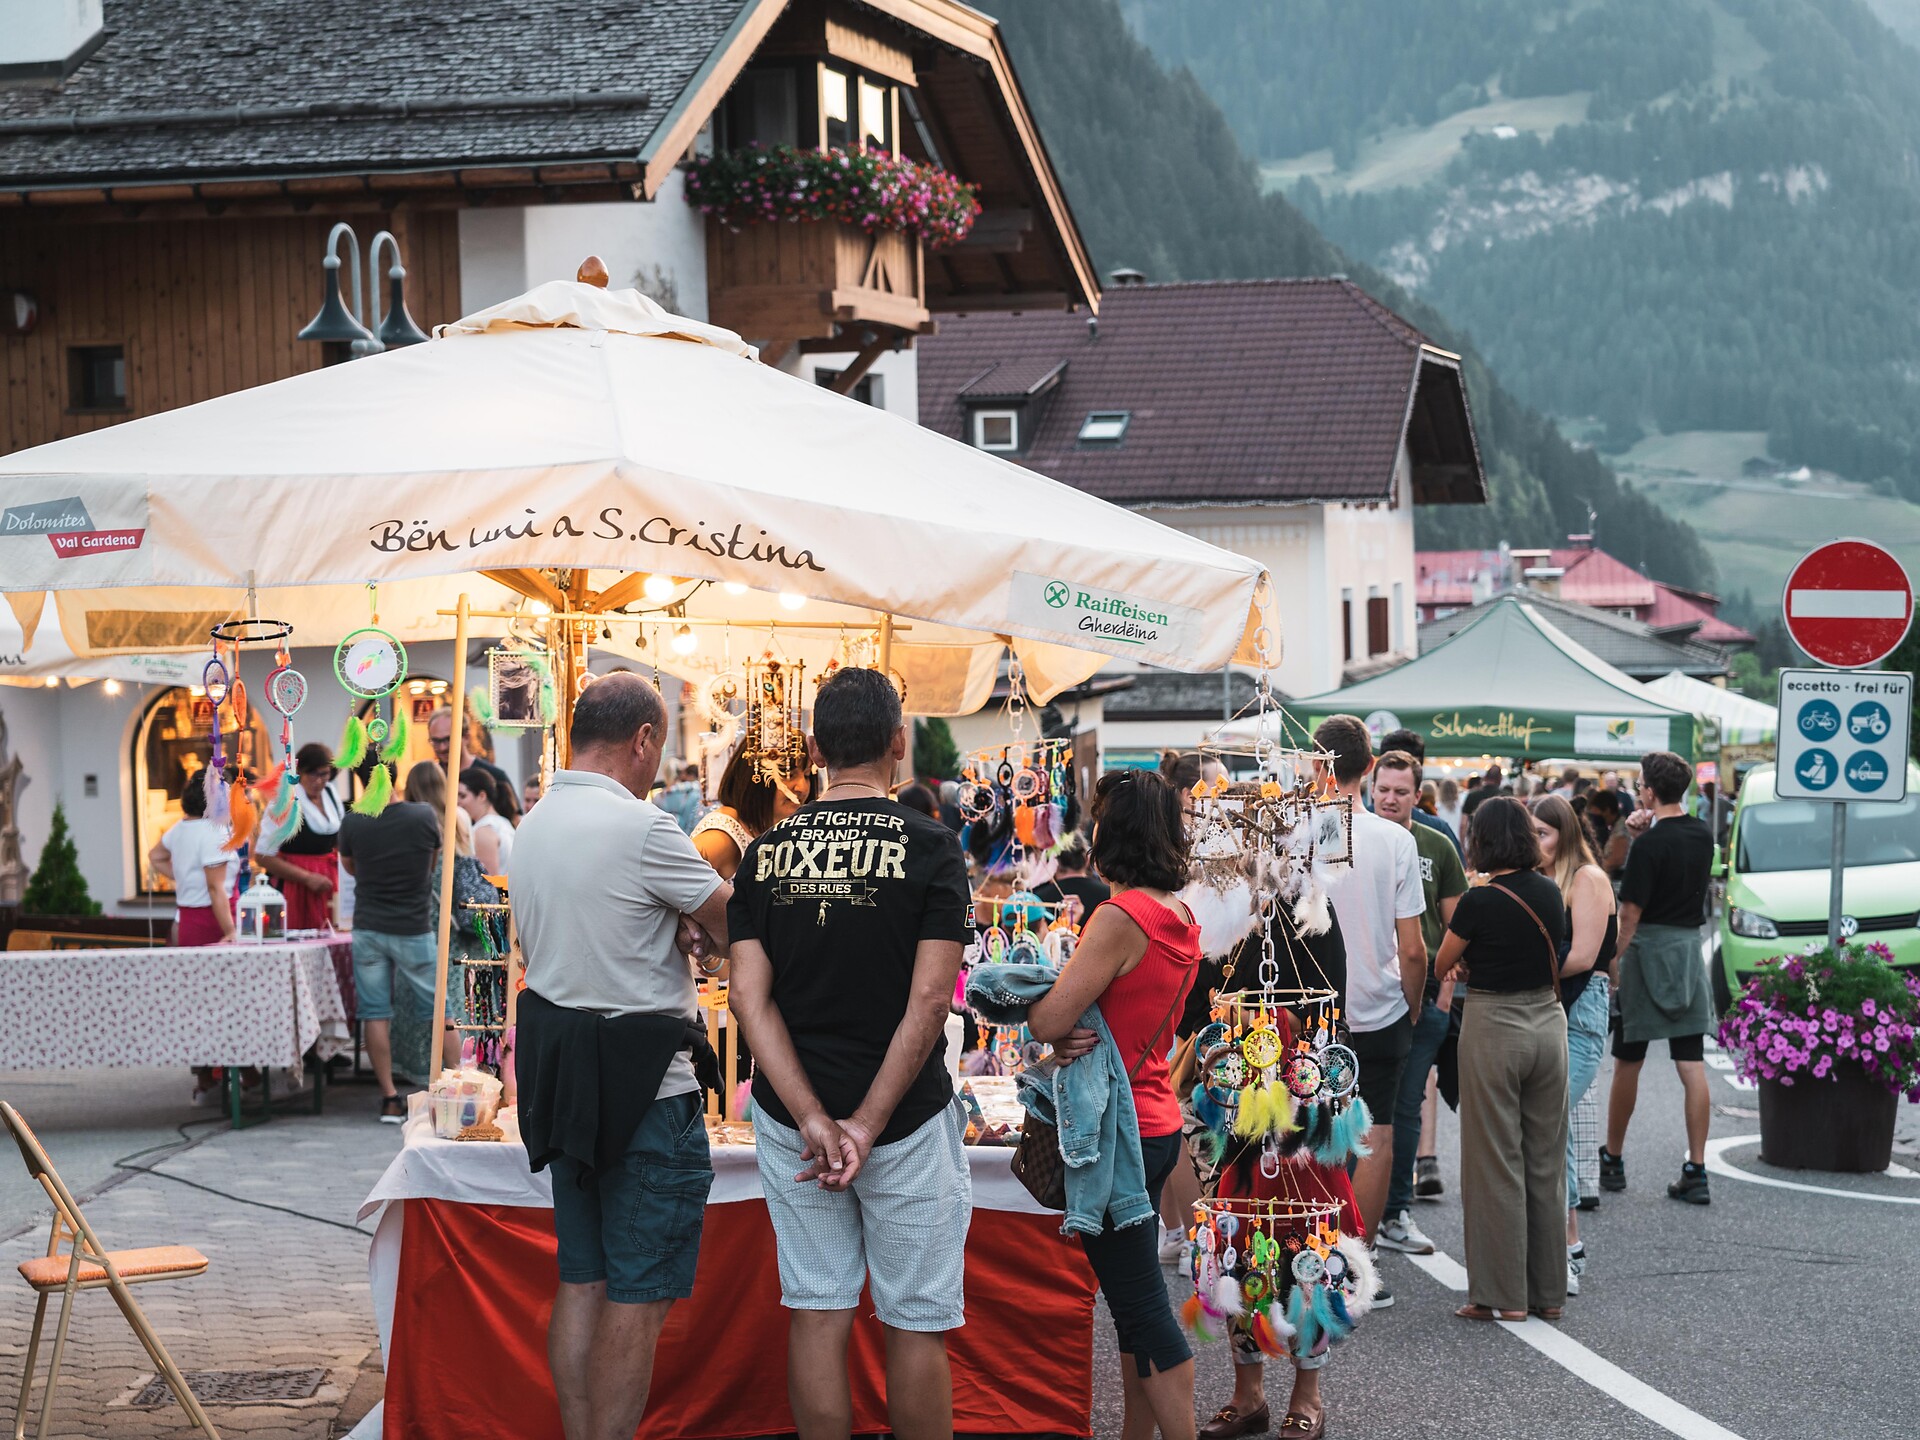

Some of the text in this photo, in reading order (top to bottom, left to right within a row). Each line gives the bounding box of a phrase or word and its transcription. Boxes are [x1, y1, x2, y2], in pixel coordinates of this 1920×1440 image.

[6, 512, 87, 531] Dolomites
[56, 534, 136, 549] Val Gardena
[369, 519, 460, 552] Bën
[553, 515, 584, 538] a
[1075, 591, 1169, 626] Raiffeisen
[1078, 615, 1159, 641] Gherdëina
[1787, 681, 1841, 693] eccetto
[1854, 682, 1879, 694] frei
[1883, 682, 1905, 695] für
[772, 811, 905, 832] THE FIGHTER
[799, 828, 861, 842] BRAND
[789, 883, 852, 894] DES RUES
